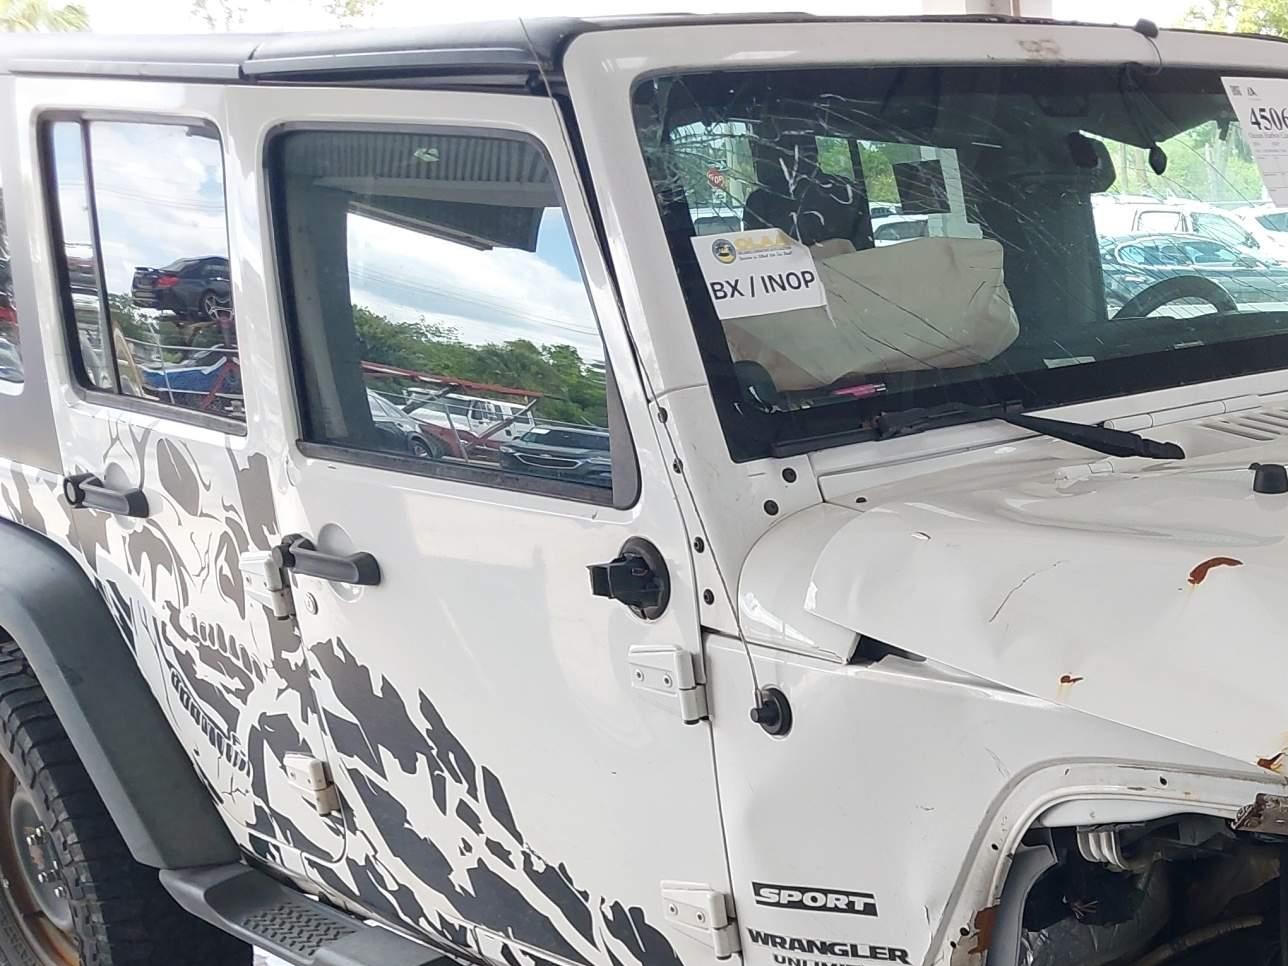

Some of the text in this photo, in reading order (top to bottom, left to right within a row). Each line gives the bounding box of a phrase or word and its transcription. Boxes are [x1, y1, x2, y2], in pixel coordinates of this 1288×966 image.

[710, 279, 745, 300] BX
[761, 271, 815, 293] INOP
[759, 887, 876, 911] SPORT
[747, 928, 912, 965] WRANGLER
